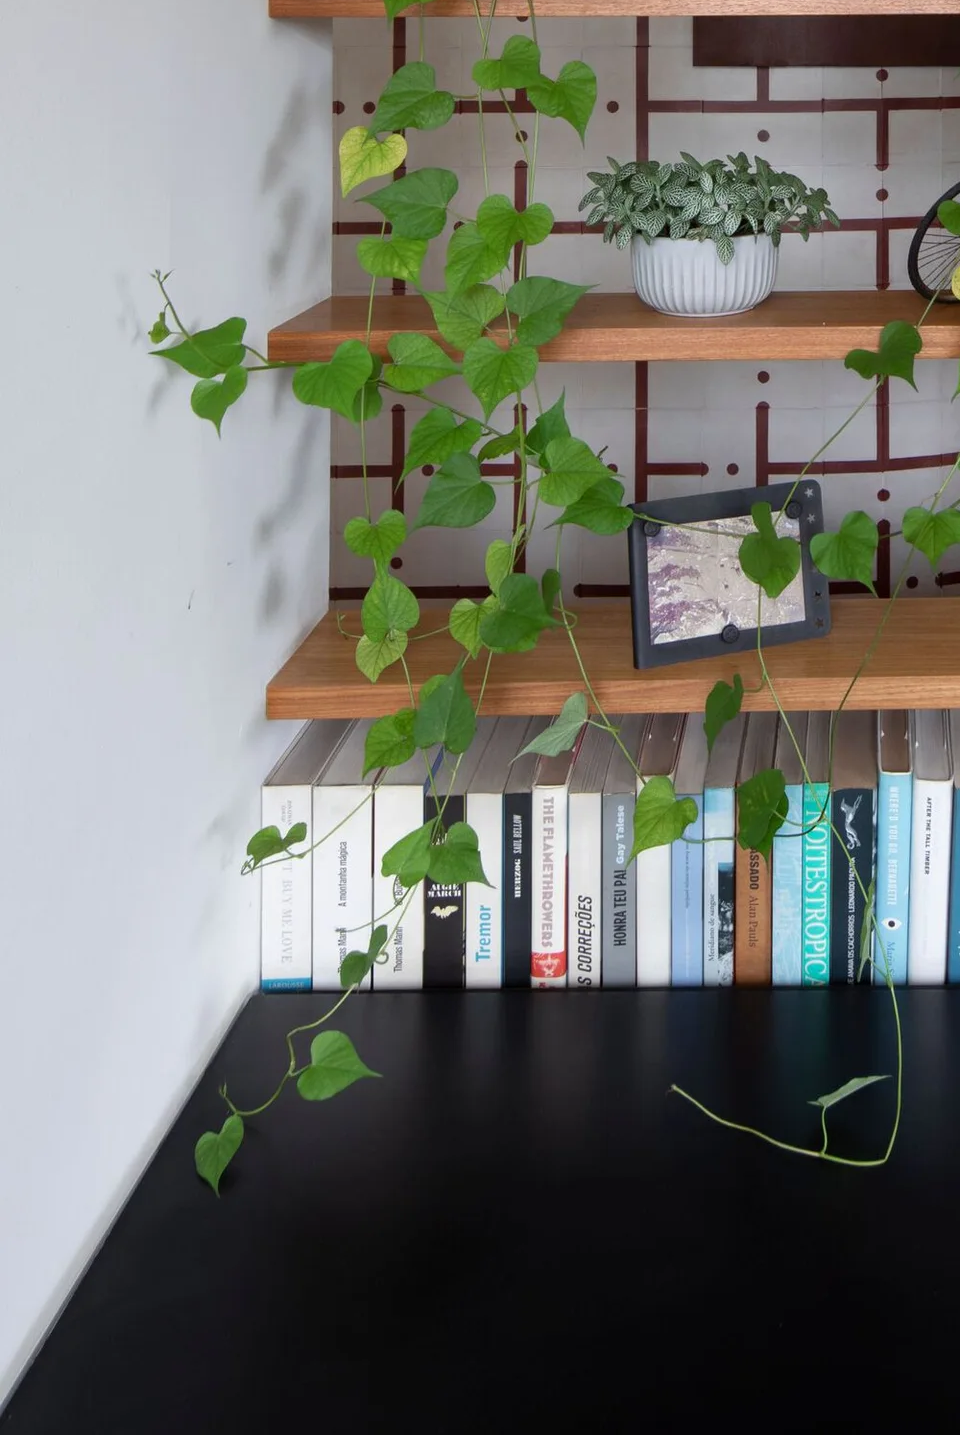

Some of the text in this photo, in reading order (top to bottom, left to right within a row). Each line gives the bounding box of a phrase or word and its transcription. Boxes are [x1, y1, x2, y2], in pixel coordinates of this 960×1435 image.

[513, 814, 522, 839] BELLOW
[616, 805, 626, 864] Gay Talese
[338, 841, 348, 866] mágica
[514, 840, 522, 854] SAUL
[888, 787, 898, 905] WHERE'D YOU BERNADETTE
[338, 867, 346, 901] montanha
[542, 797, 554, 947] THE FLAMETHROWERS
[282, 879, 292, 905] BUY
[848, 881, 856, 913] LEONARDO
[282, 908, 292, 927] ME
[476, 905, 491, 962] Tremor
[575, 895, 594, 972] CORREÇÕES
[613, 890, 626, 946] HONRA TEU
[748, 895, 758, 947] Alan Pauls
[282, 931, 292, 964] LOVE
[394, 947, 402, 972] Thomas
